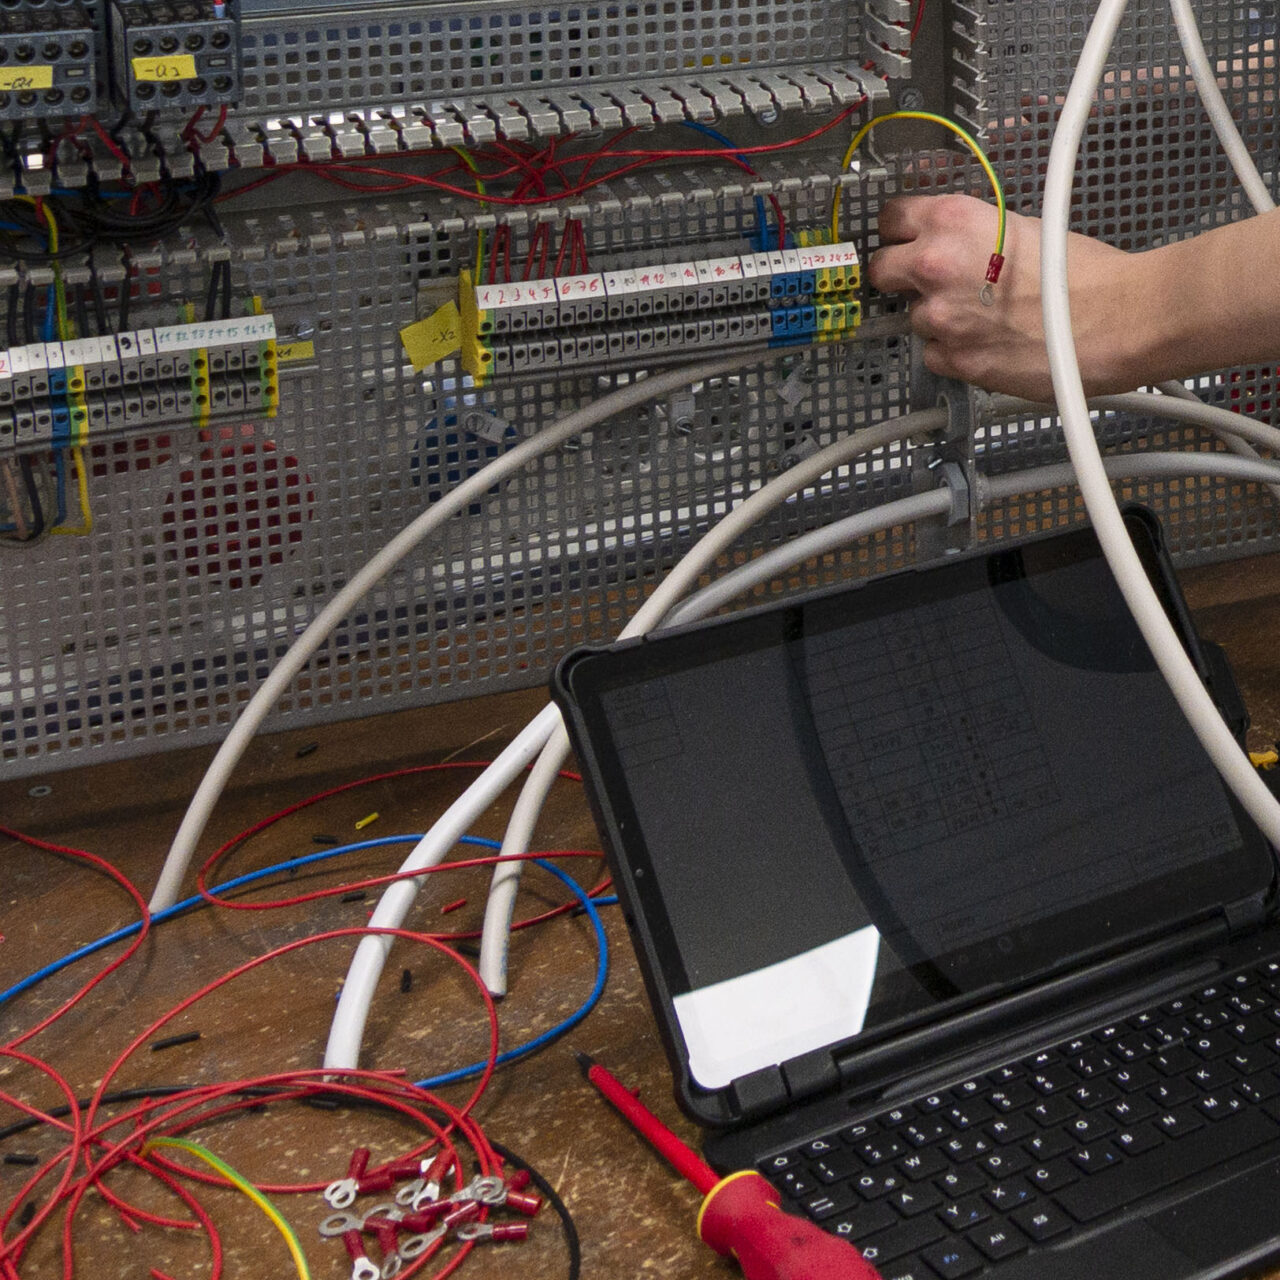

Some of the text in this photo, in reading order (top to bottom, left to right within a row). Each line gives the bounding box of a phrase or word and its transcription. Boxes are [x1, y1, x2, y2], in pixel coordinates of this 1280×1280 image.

[484, 291, 490, 302] 1
[499, 289, 507, 305] 2
[514, 287, 521, 302] 3
[528, 289, 537, 300] 4
[562, 282, 571, 295] 6
[653, 272, 665, 285] 12
[120, 336, 132, 350] 9
[1117, 1103, 1129, 1113] H
[1197, 1070, 1209, 1078] K
[906, 1157, 920, 1167] W
[950, 1141, 961, 1150] E
[1078, 1088, 1089, 1098] Z
[1118, 1072, 1129, 1080] U
[993, 1188, 1005, 1198] X
[1079, 1151, 1089, 1160] V
[1163, 1116, 1175, 1124] N
[1204, 1098, 1217, 1107] M
